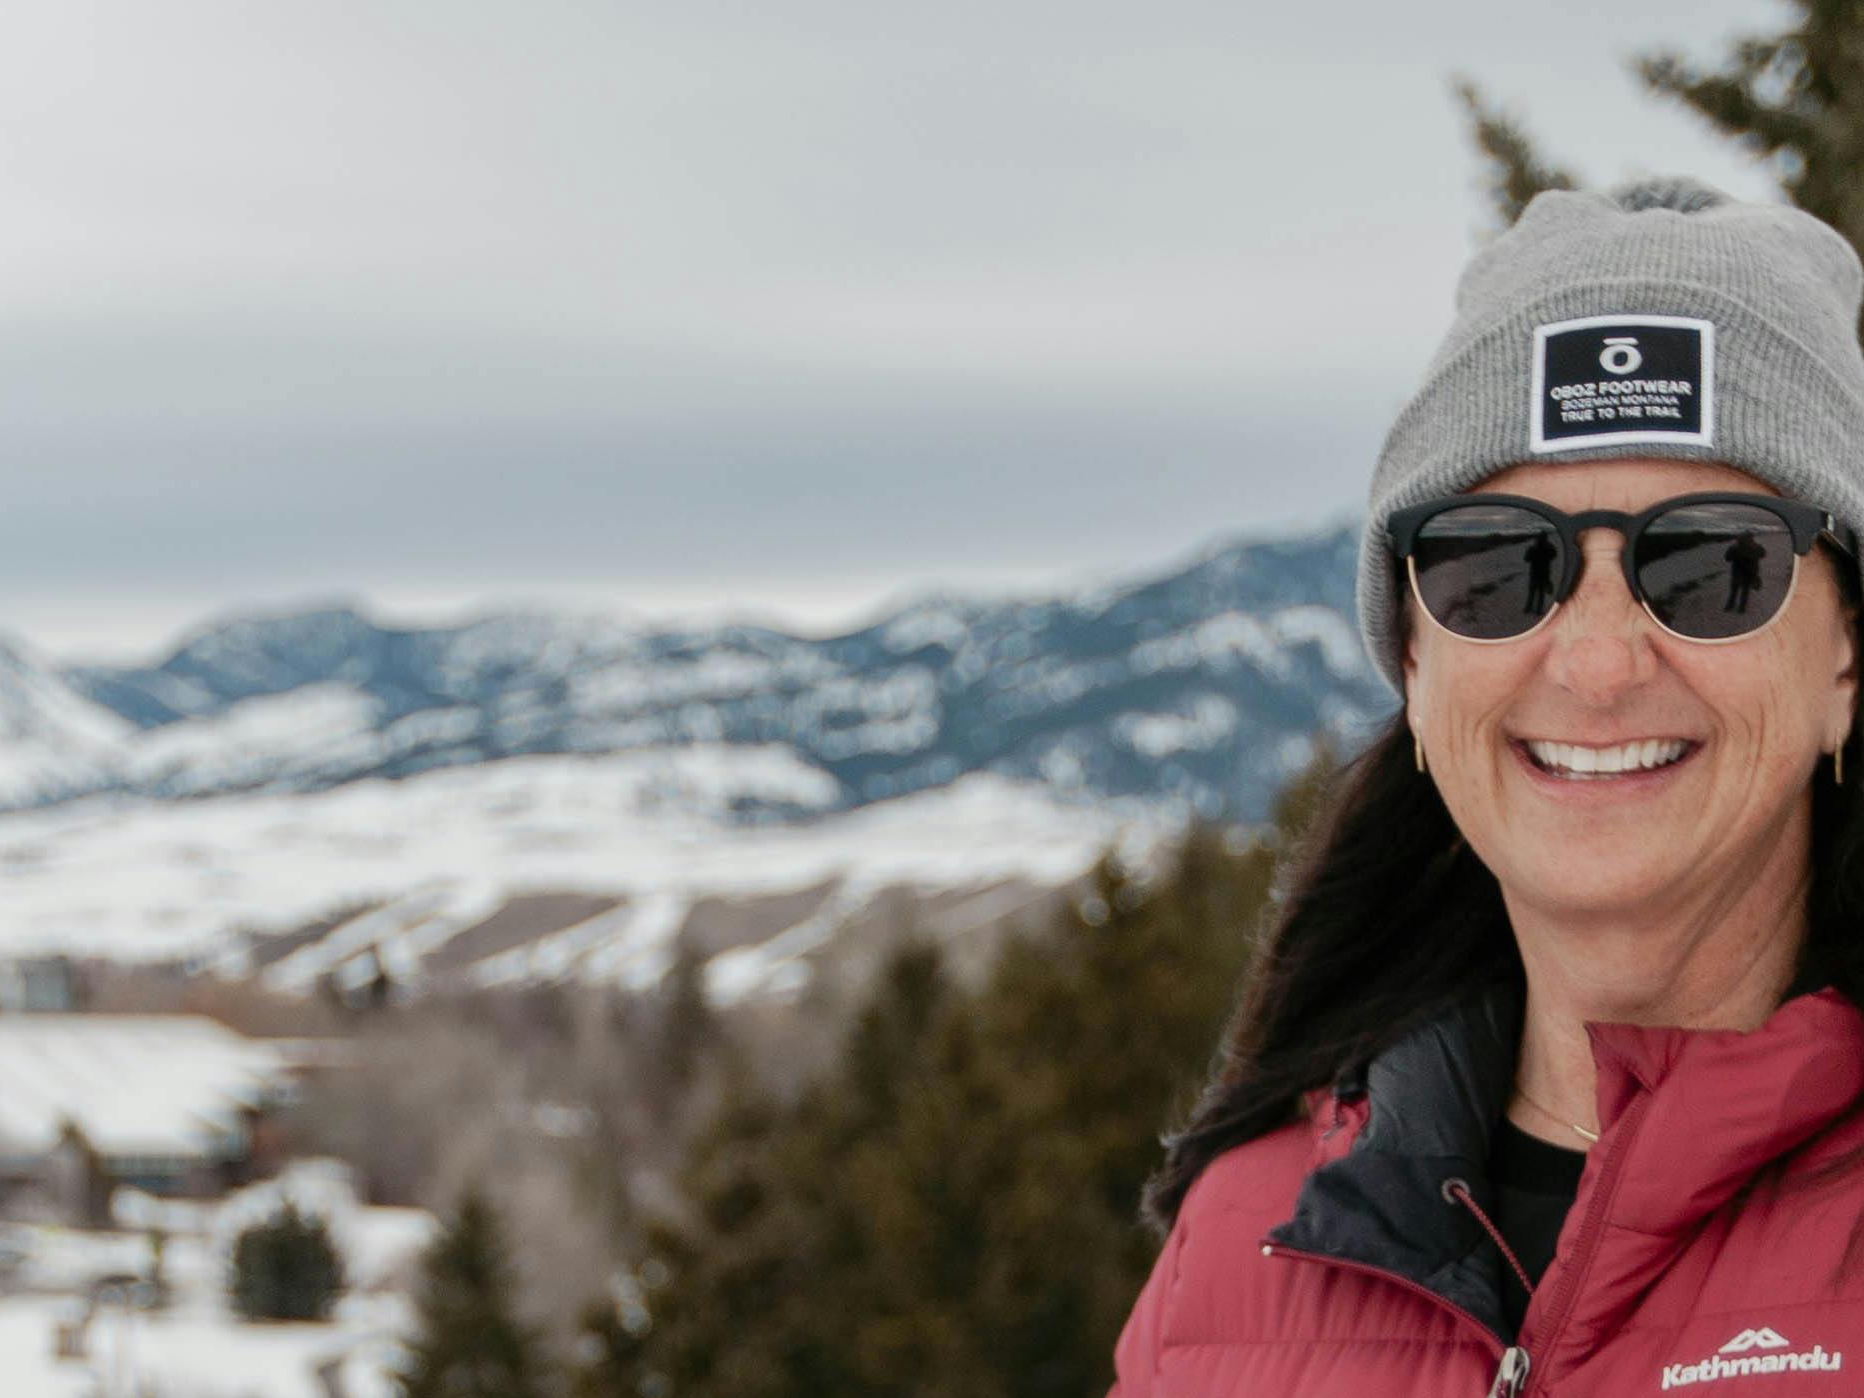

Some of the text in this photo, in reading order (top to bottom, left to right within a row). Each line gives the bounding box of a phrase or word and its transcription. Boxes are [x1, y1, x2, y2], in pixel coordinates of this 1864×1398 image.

[1550, 380, 1692, 400] OBOZ FOOTWEAR
[1562, 395, 1679, 410] BOZEMAN MONTANA
[1560, 406, 1682, 423] TRUE TO THE TRAIL
[1661, 1345, 1842, 1390] Kathmandu
